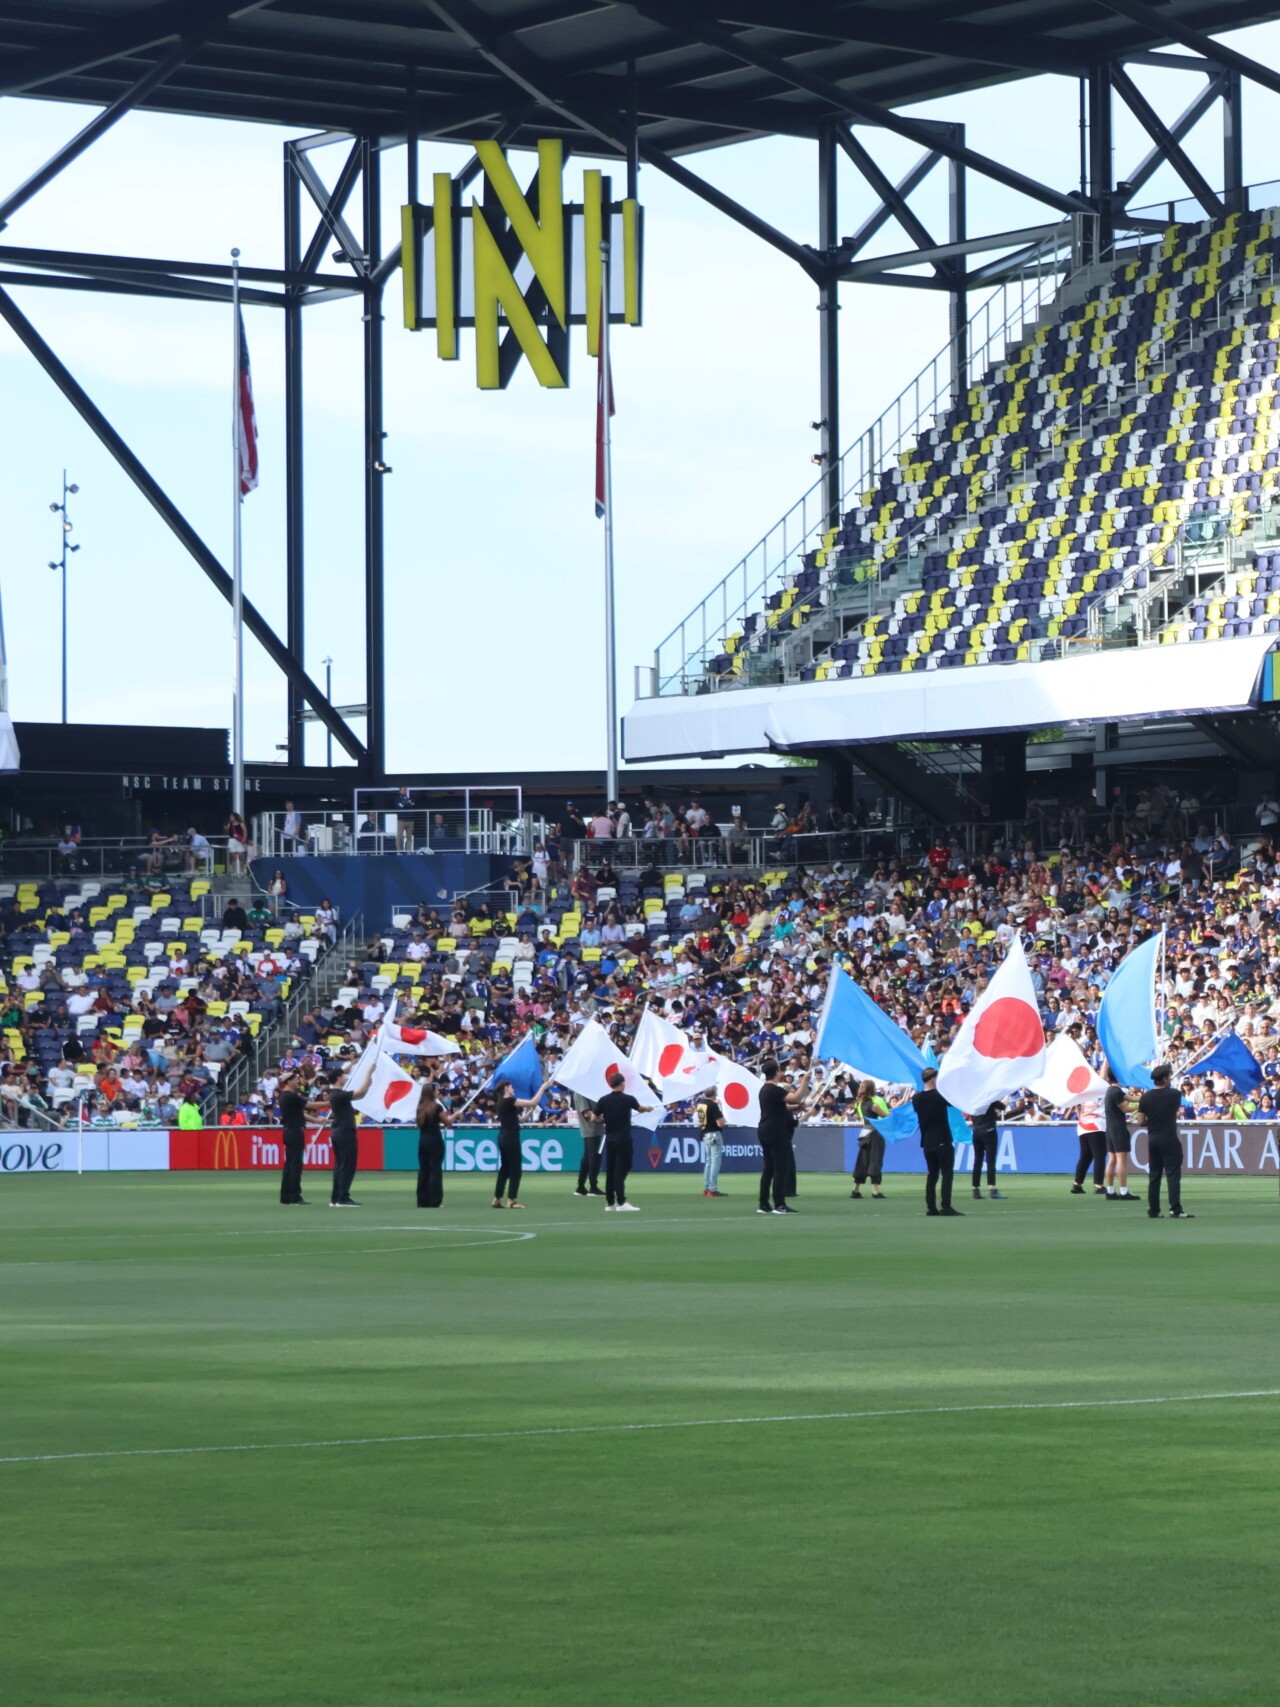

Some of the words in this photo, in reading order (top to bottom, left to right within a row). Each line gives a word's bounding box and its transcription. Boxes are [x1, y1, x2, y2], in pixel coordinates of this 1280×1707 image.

[122, 776, 151, 789] NSC
[163, 777, 202, 790] TEAM
[213, 778, 261, 791] STRE
[0, 1143, 63, 1171] ove
[252, 1136, 279, 1165] i'm
[442, 1130, 564, 1171] isese
[1130, 1129, 1245, 1173] QTAR
